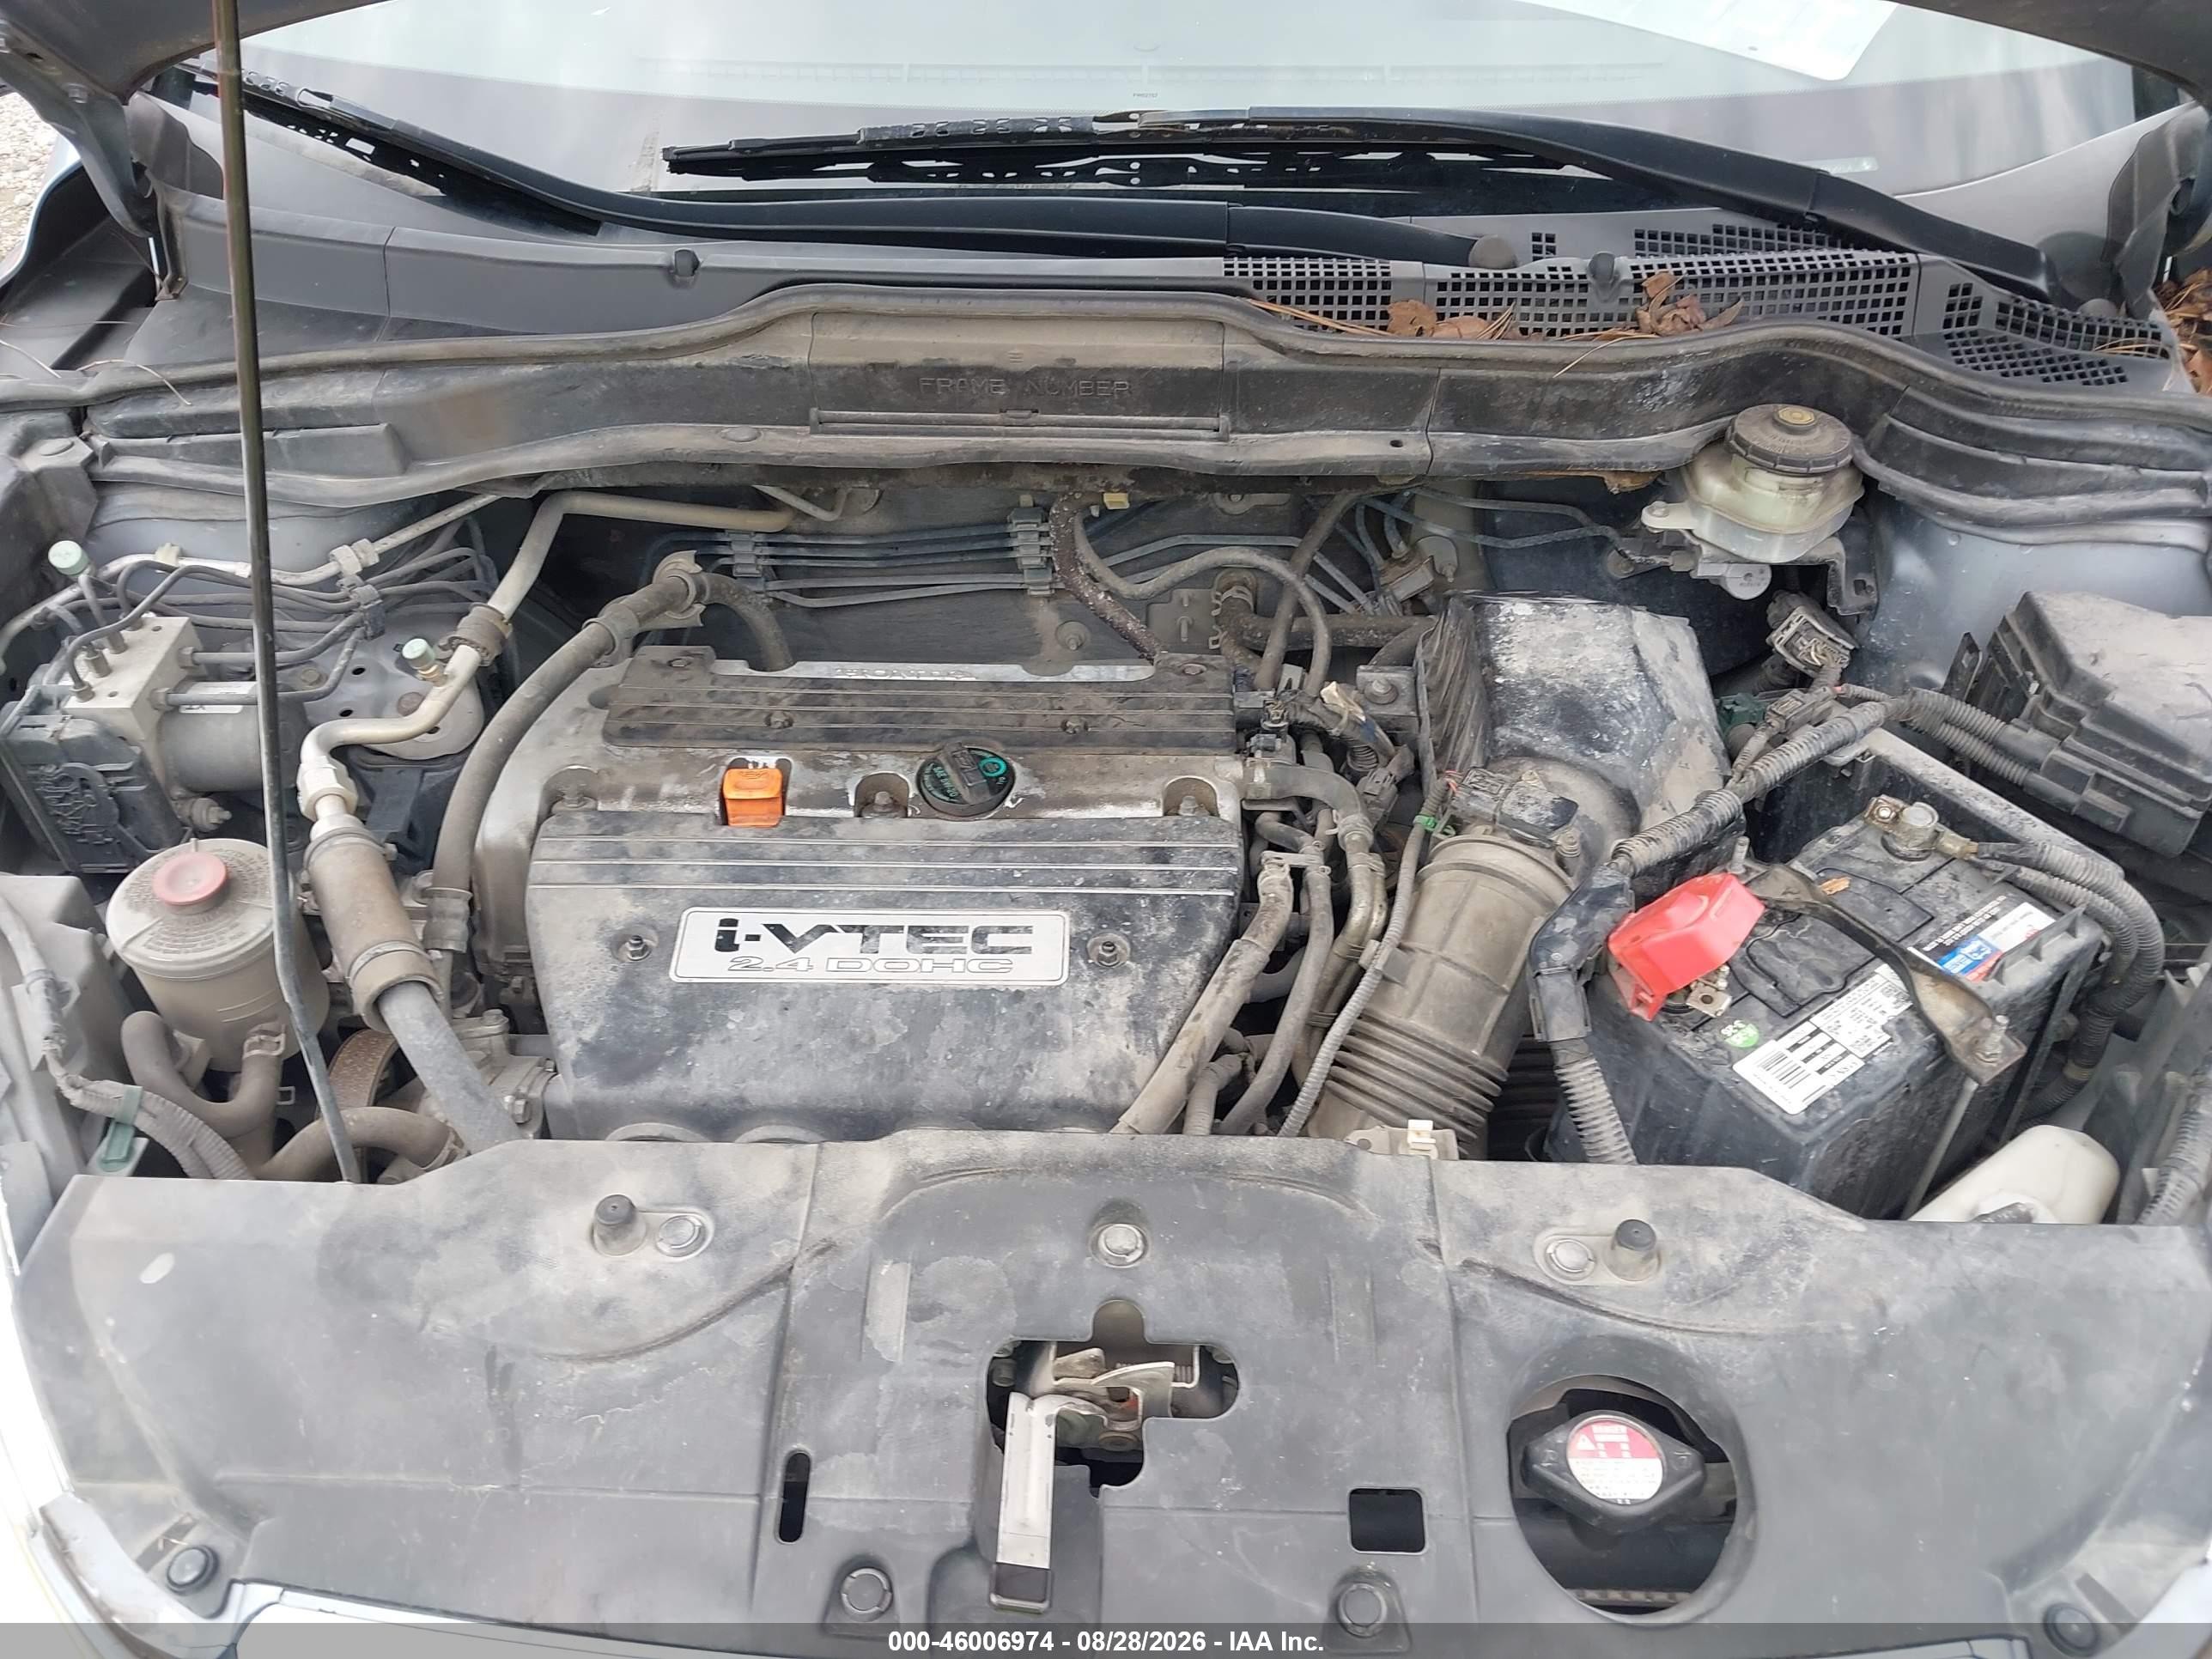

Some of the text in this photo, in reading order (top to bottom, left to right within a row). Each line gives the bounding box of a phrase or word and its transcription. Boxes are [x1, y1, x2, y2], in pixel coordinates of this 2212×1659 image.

[919, 378, 1131, 398] FRAME NUMBER
[714, 917, 1033, 955] i-VTEC
[727, 956, 1013, 974] 2.4 DOHC
